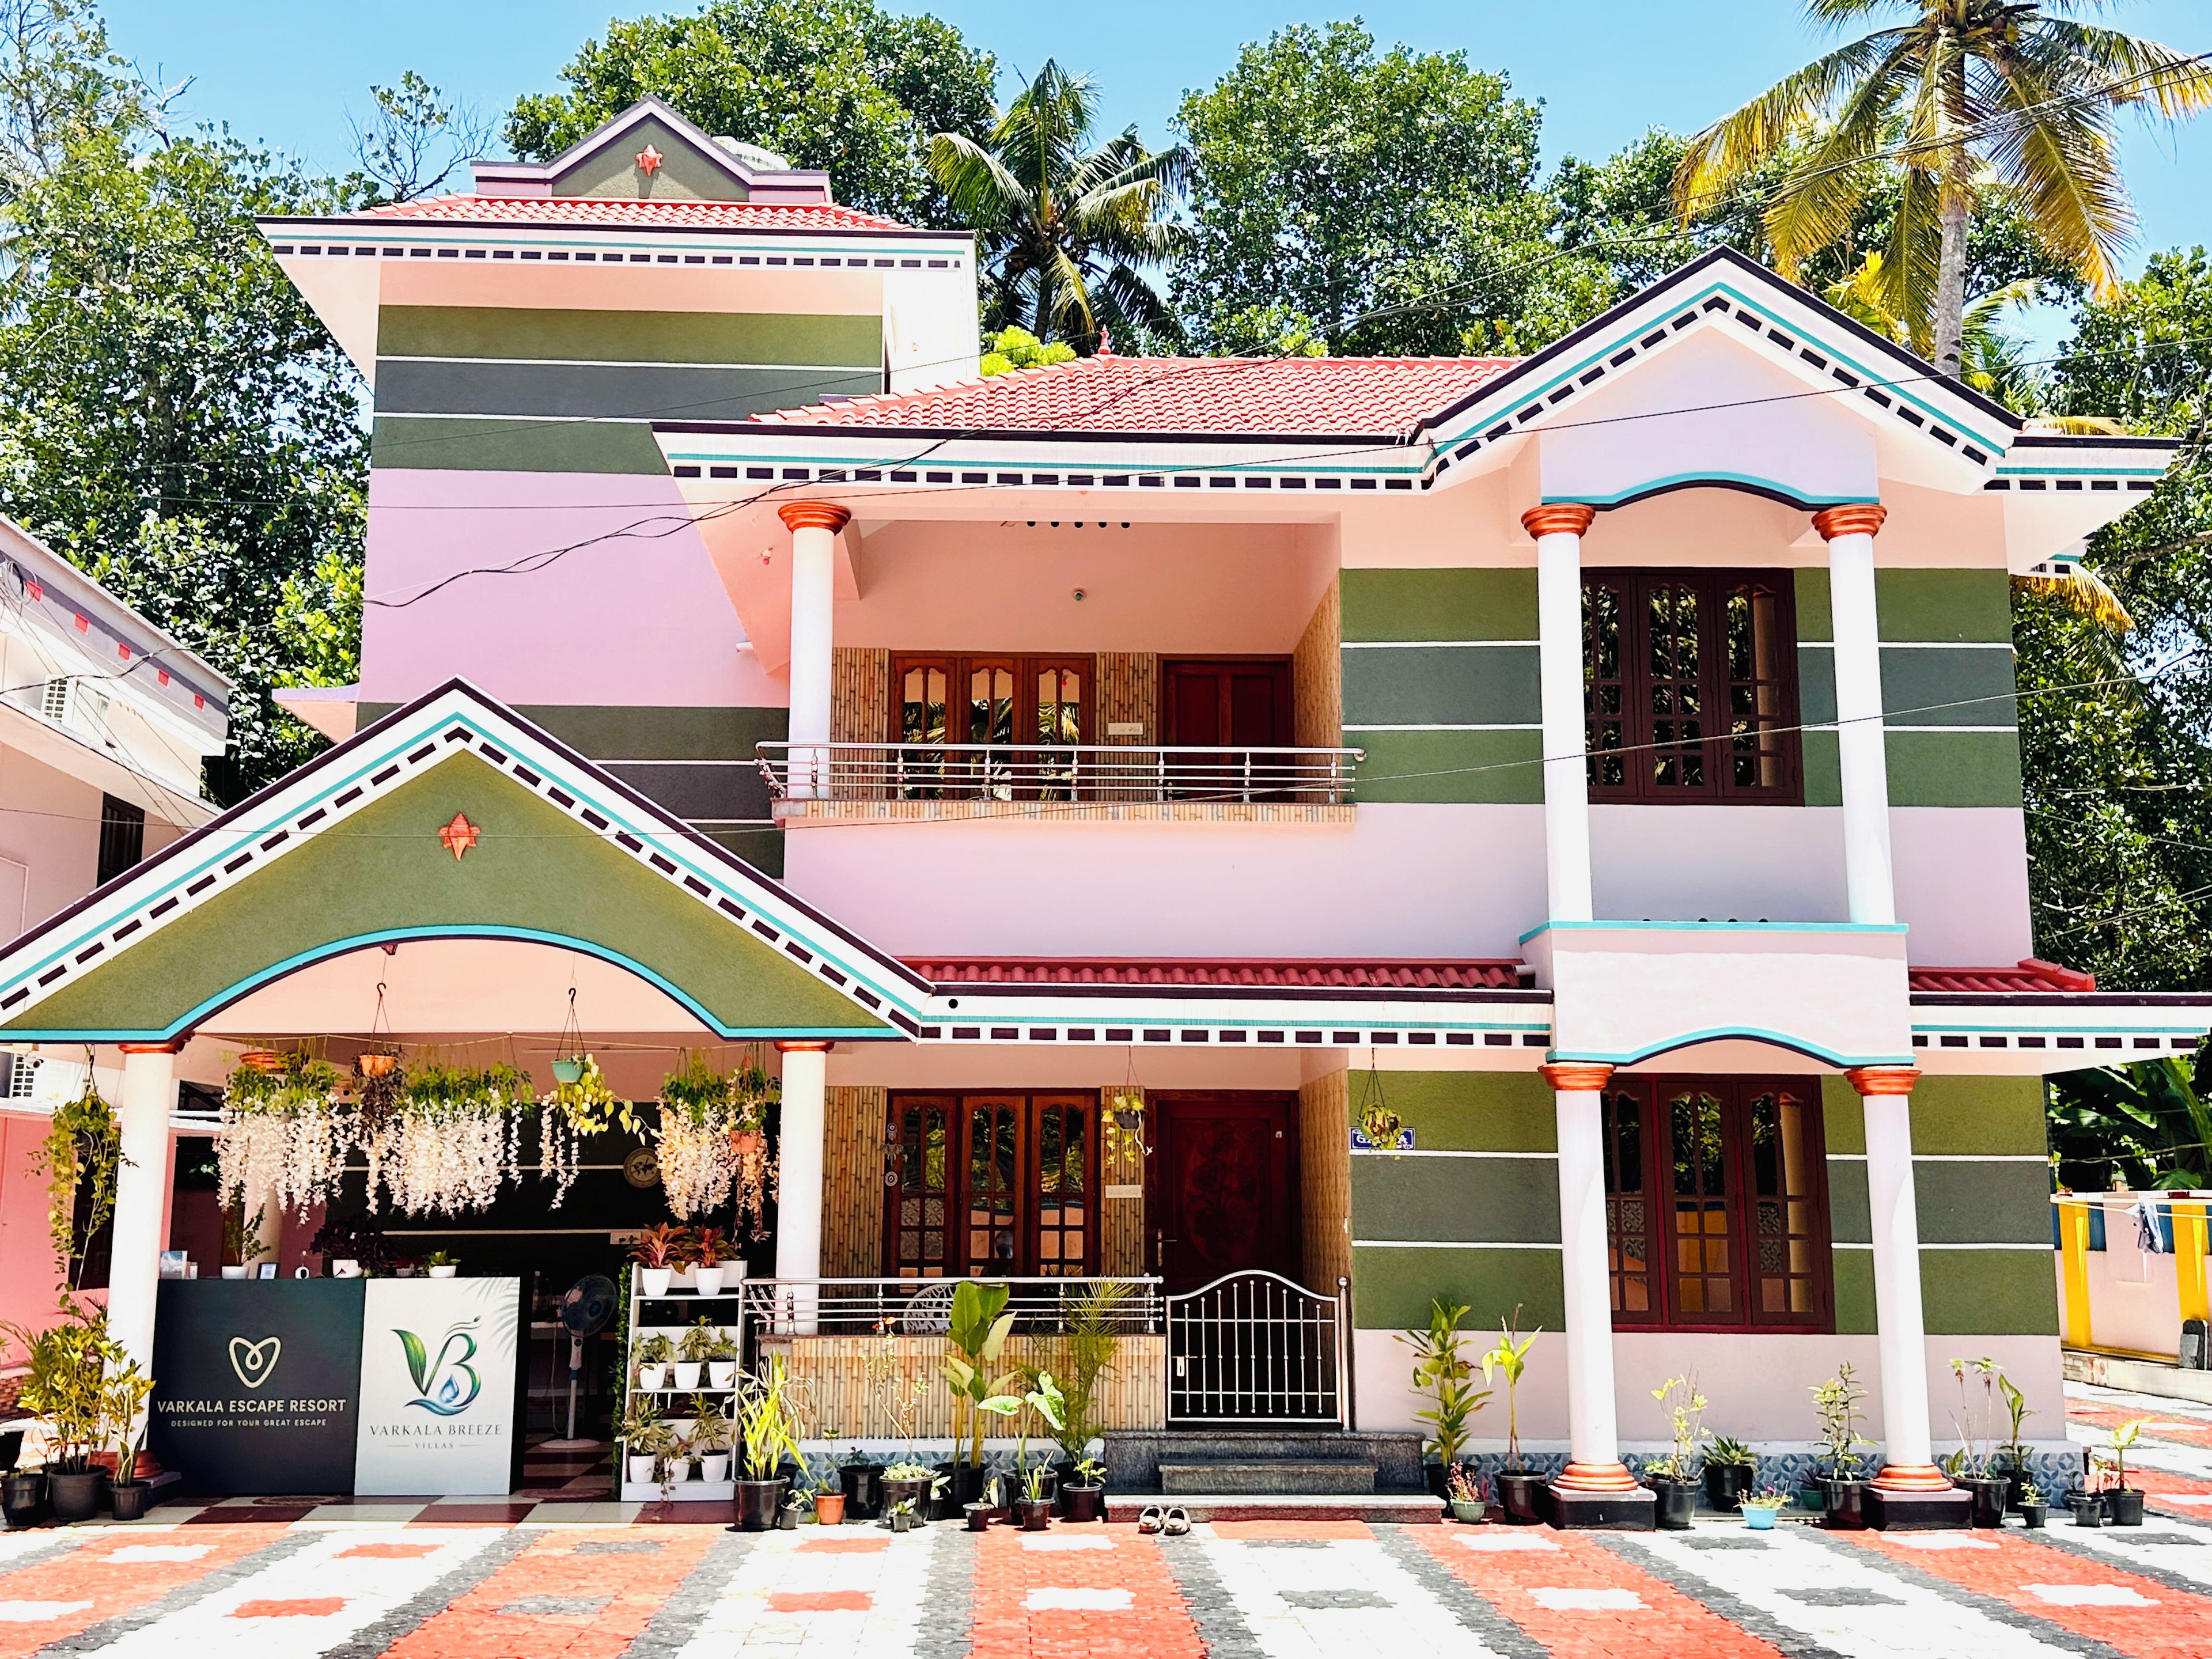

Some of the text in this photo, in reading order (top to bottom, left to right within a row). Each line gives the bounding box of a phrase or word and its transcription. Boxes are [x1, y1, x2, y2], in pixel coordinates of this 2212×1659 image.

[157, 1399, 346, 1413] VARKALA ESCAPE RESORT
[370, 1424, 502, 1435] VARKALA BREEZE
